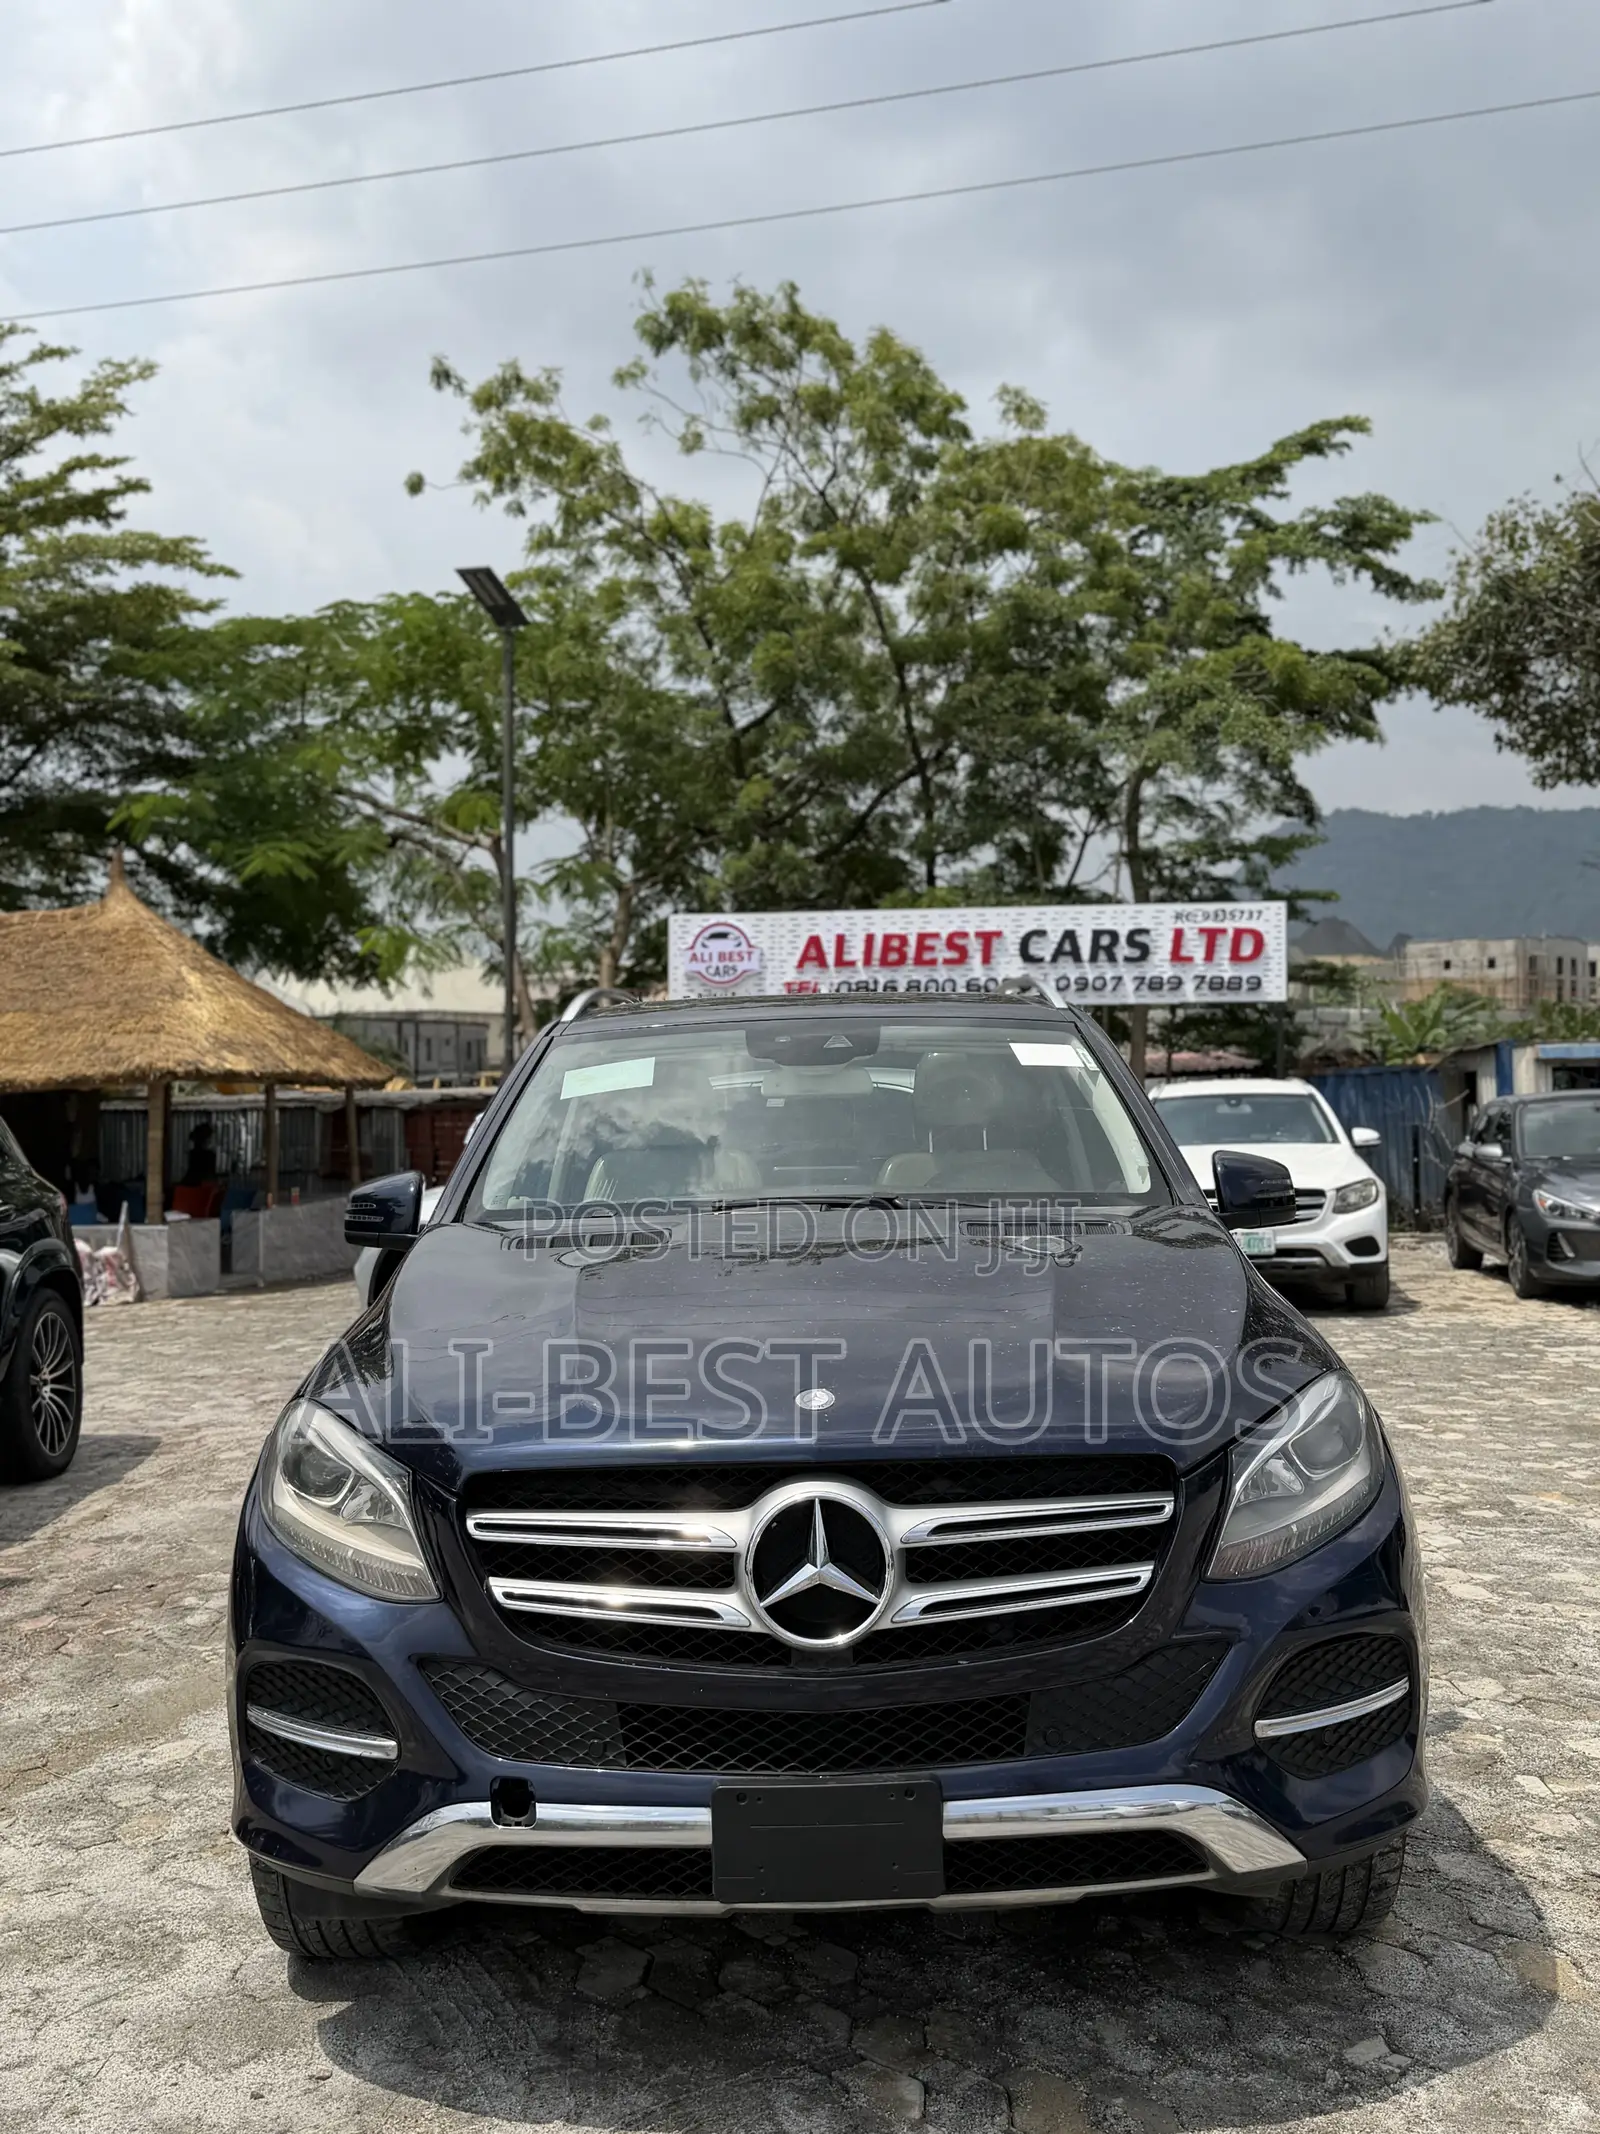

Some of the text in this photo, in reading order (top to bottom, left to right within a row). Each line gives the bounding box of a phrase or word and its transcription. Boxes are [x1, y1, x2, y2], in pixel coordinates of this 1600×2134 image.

[797, 927, 1265, 968] ALIBEST CARS LTD
[689, 951, 754, 963] ALI BEST
[705, 964, 738, 978] CARS
[1055, 974, 1123, 992] 0907
[1133, 975, 1183, 992] 789
[1193, 974, 1262, 992] 7889
